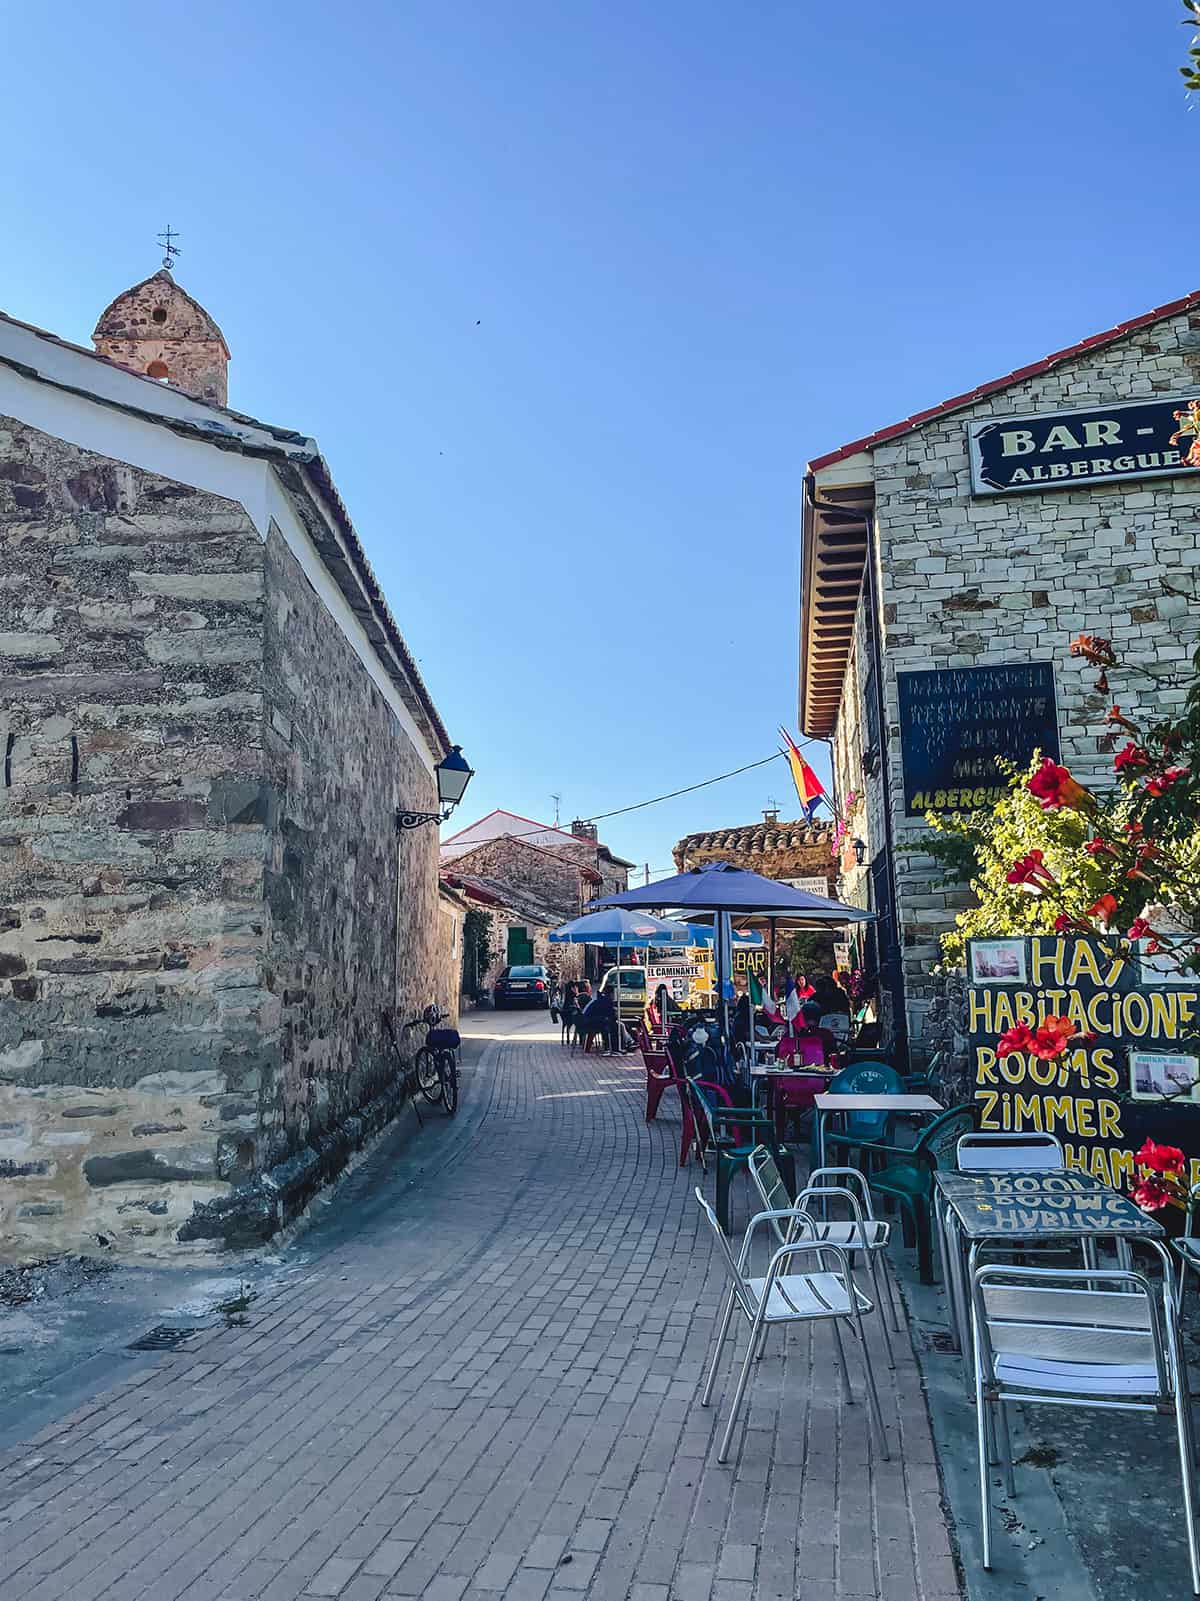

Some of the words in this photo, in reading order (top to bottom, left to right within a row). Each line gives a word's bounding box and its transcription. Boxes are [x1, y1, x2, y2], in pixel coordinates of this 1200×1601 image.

[1000, 420, 1123, 457] BAR
[1009, 450, 1182, 483] ALBERGUE
[656, 966, 699, 977] CAMINANTE
[736, 951, 765, 972] BAR
[1030, 938, 1132, 988] HAY
[976, 1046, 1120, 1089] ROOMS
[974, 1091, 1124, 1139] ZiMMER
